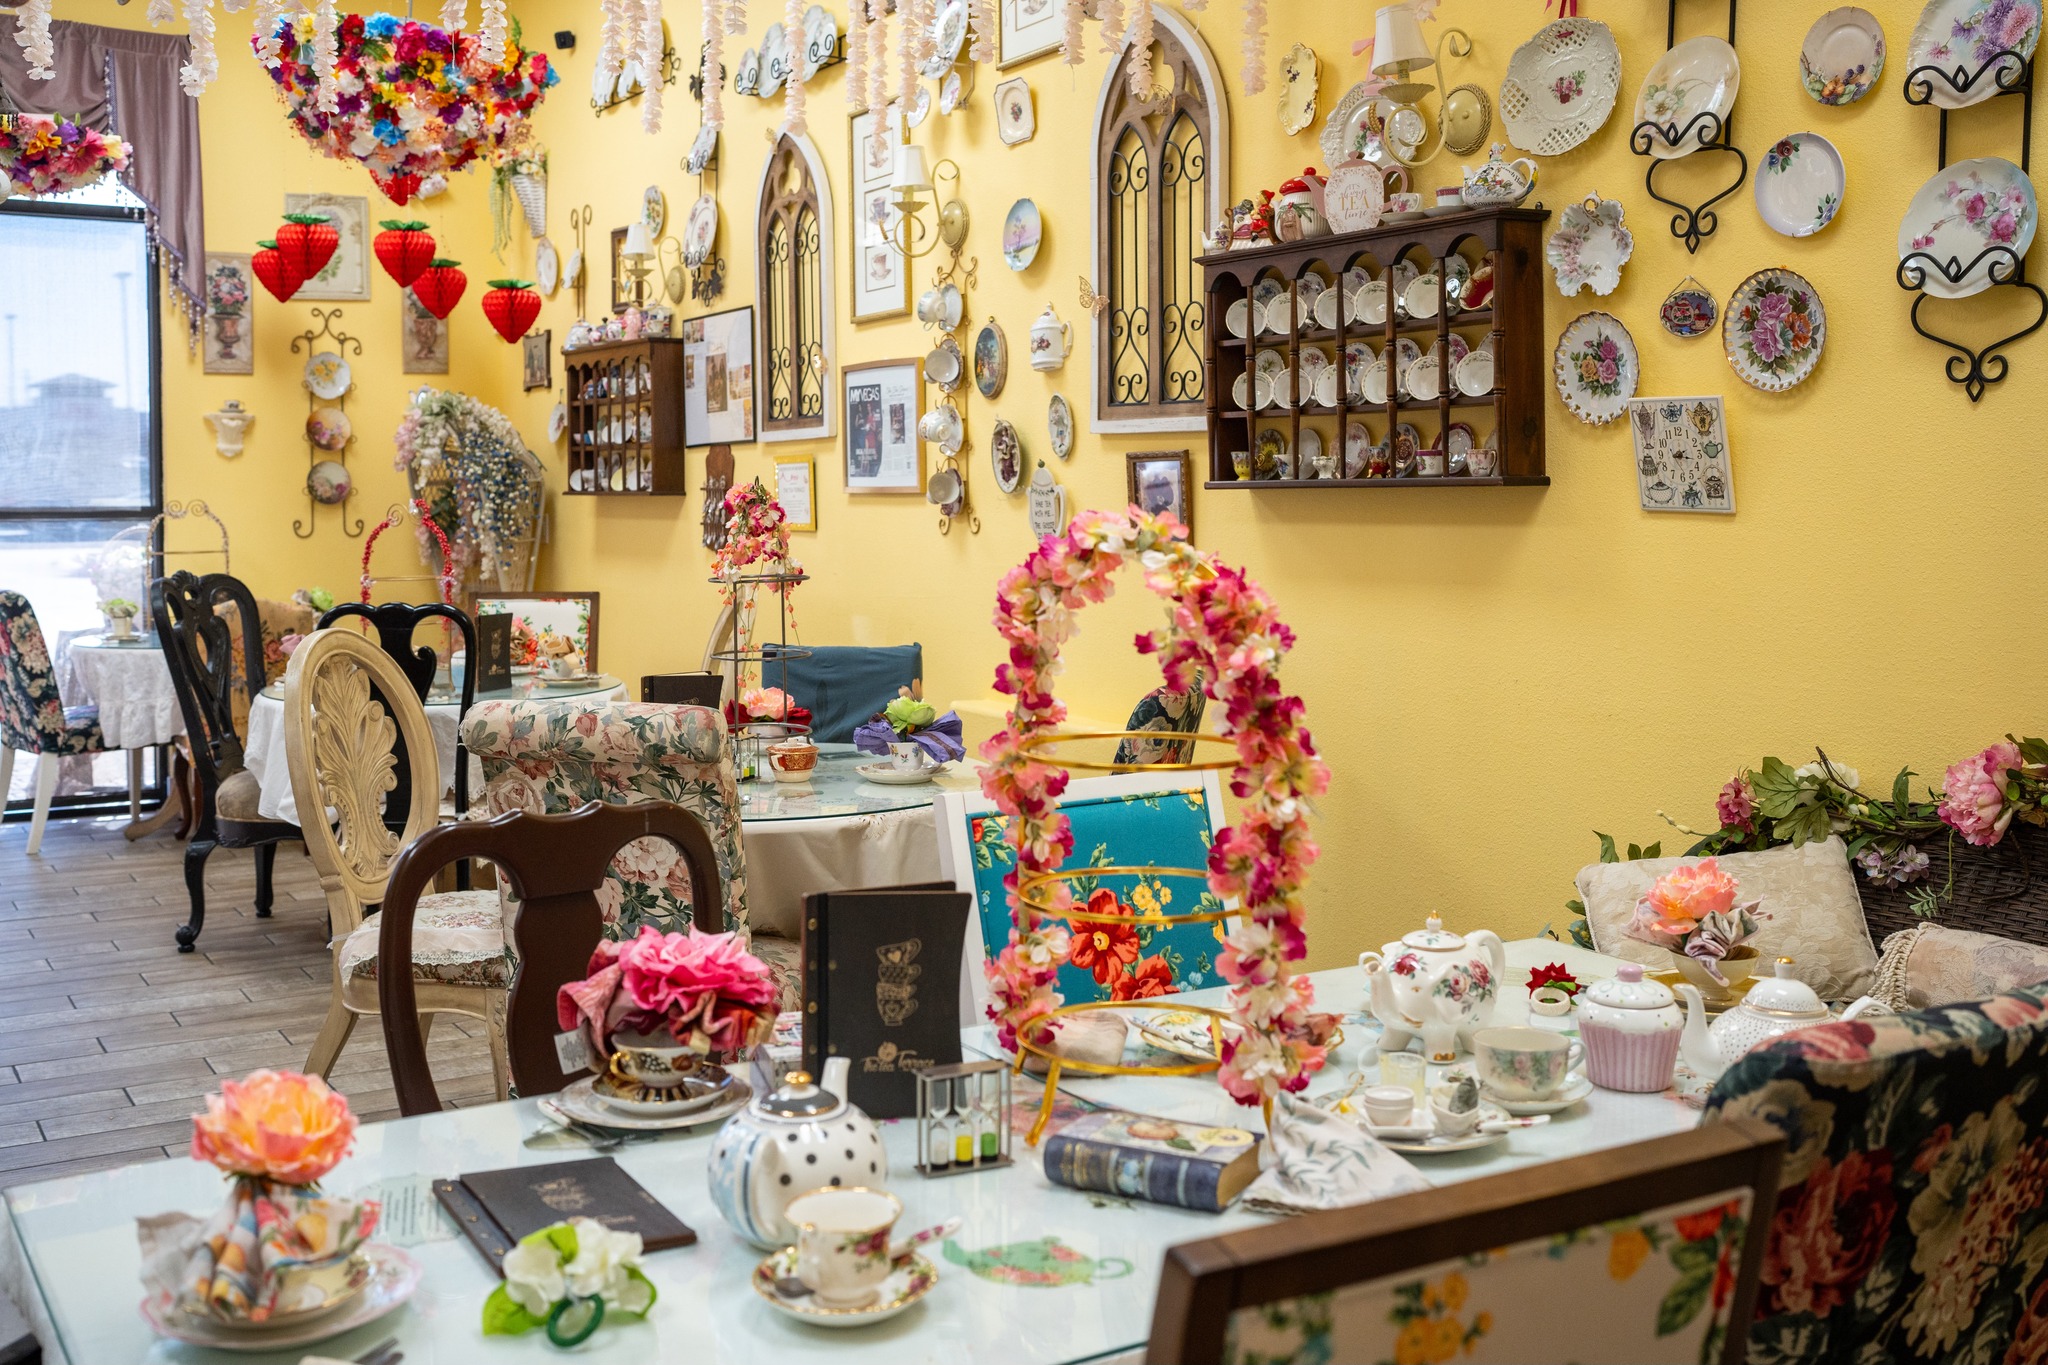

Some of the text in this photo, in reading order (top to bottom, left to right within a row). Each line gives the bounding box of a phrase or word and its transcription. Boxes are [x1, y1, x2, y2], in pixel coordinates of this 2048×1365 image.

[1340, 195, 1370, 211] TEA
[1345, 207, 1369, 220] time
[1665, 430, 1672, 439] 11
[1674, 426, 1682, 436] 12
[1659, 438, 1667, 448] 10
[1692, 438, 1698, 447] 2
[1658, 450, 1664, 460] 9
[1697, 450, 1702, 459] 3
[1662, 462, 1668, 471] 8
[1694, 462, 1700, 471] 4
[1680, 472, 1686, 482] 6
[1689, 470, 1694, 480] 5
